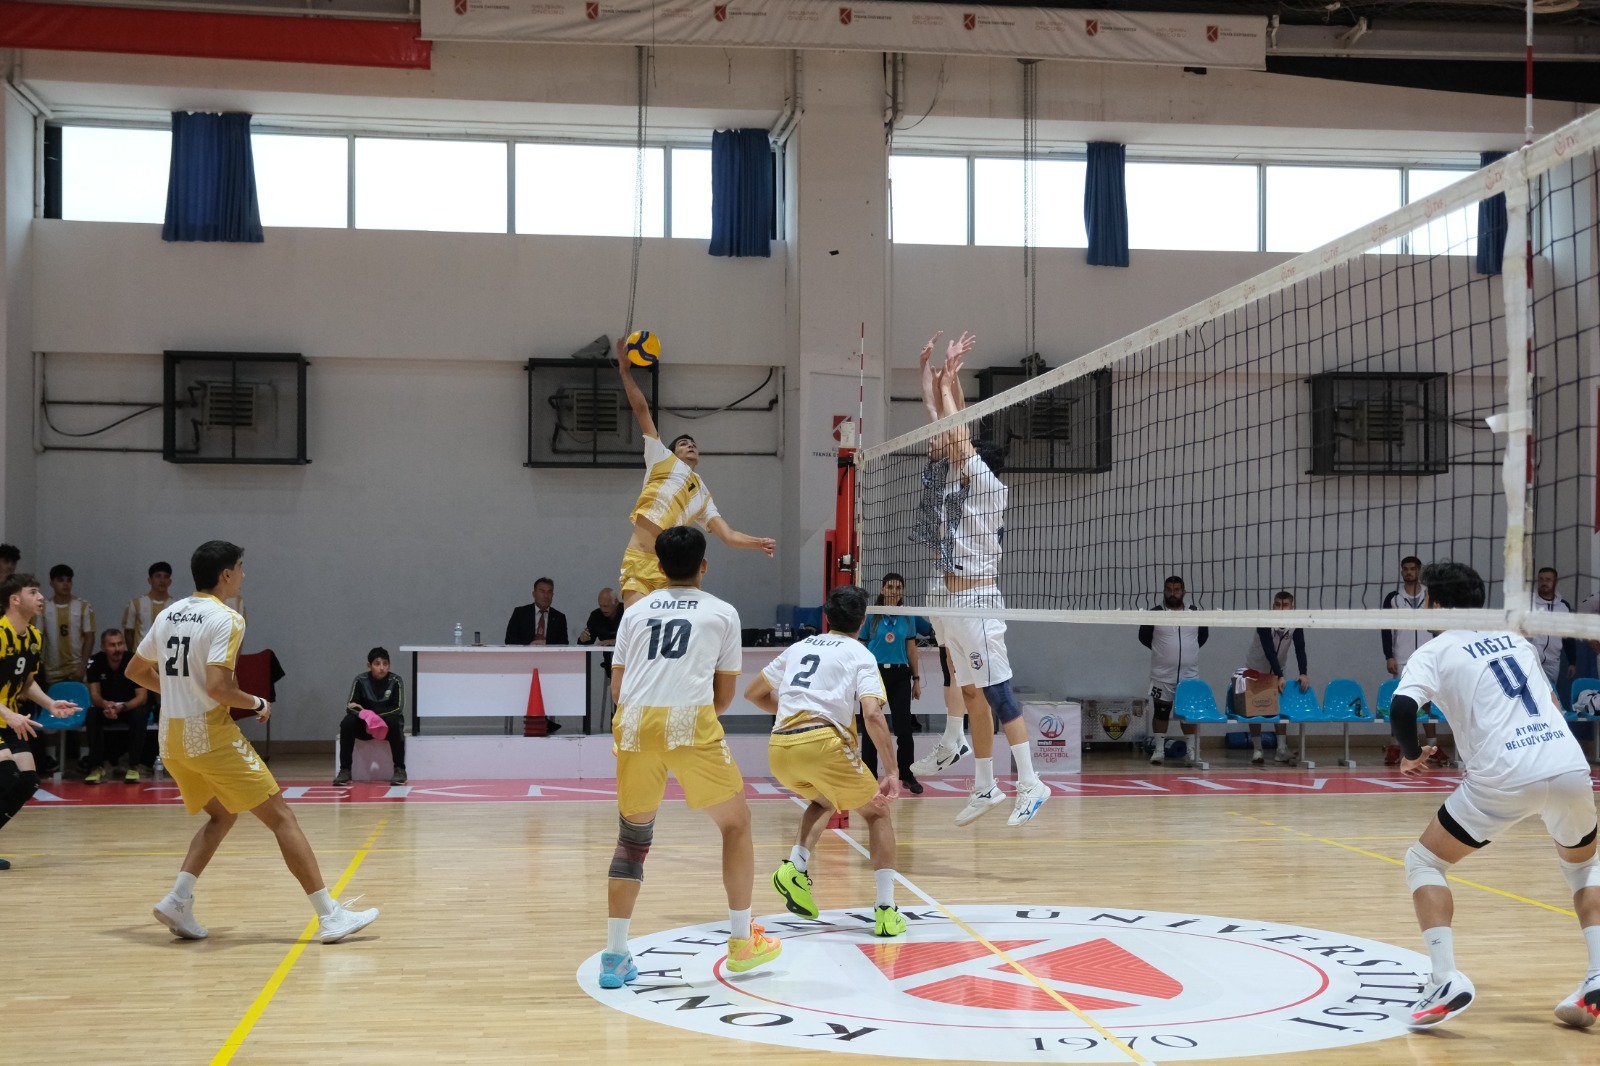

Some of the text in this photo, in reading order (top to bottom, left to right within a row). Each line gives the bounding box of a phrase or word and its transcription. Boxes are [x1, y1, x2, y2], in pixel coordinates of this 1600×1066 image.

[649, 598, 699, 610] ÖMER
[59, 624, 69, 637] 6
[646, 618, 693, 660] 10
[804, 637, 845, 647] BULUT
[1462, 635, 1517, 659] YAĞIZ
[14, 656, 26, 675] 9
[165, 636, 191, 677] 21
[789, 653, 821, 689] 2
[1150, 685, 1163, 699] 55
[1486, 654, 1541, 717] 4
[1515, 722, 1550, 737] ATAKUM
[1029, 1034, 1199, 1051] 1970
